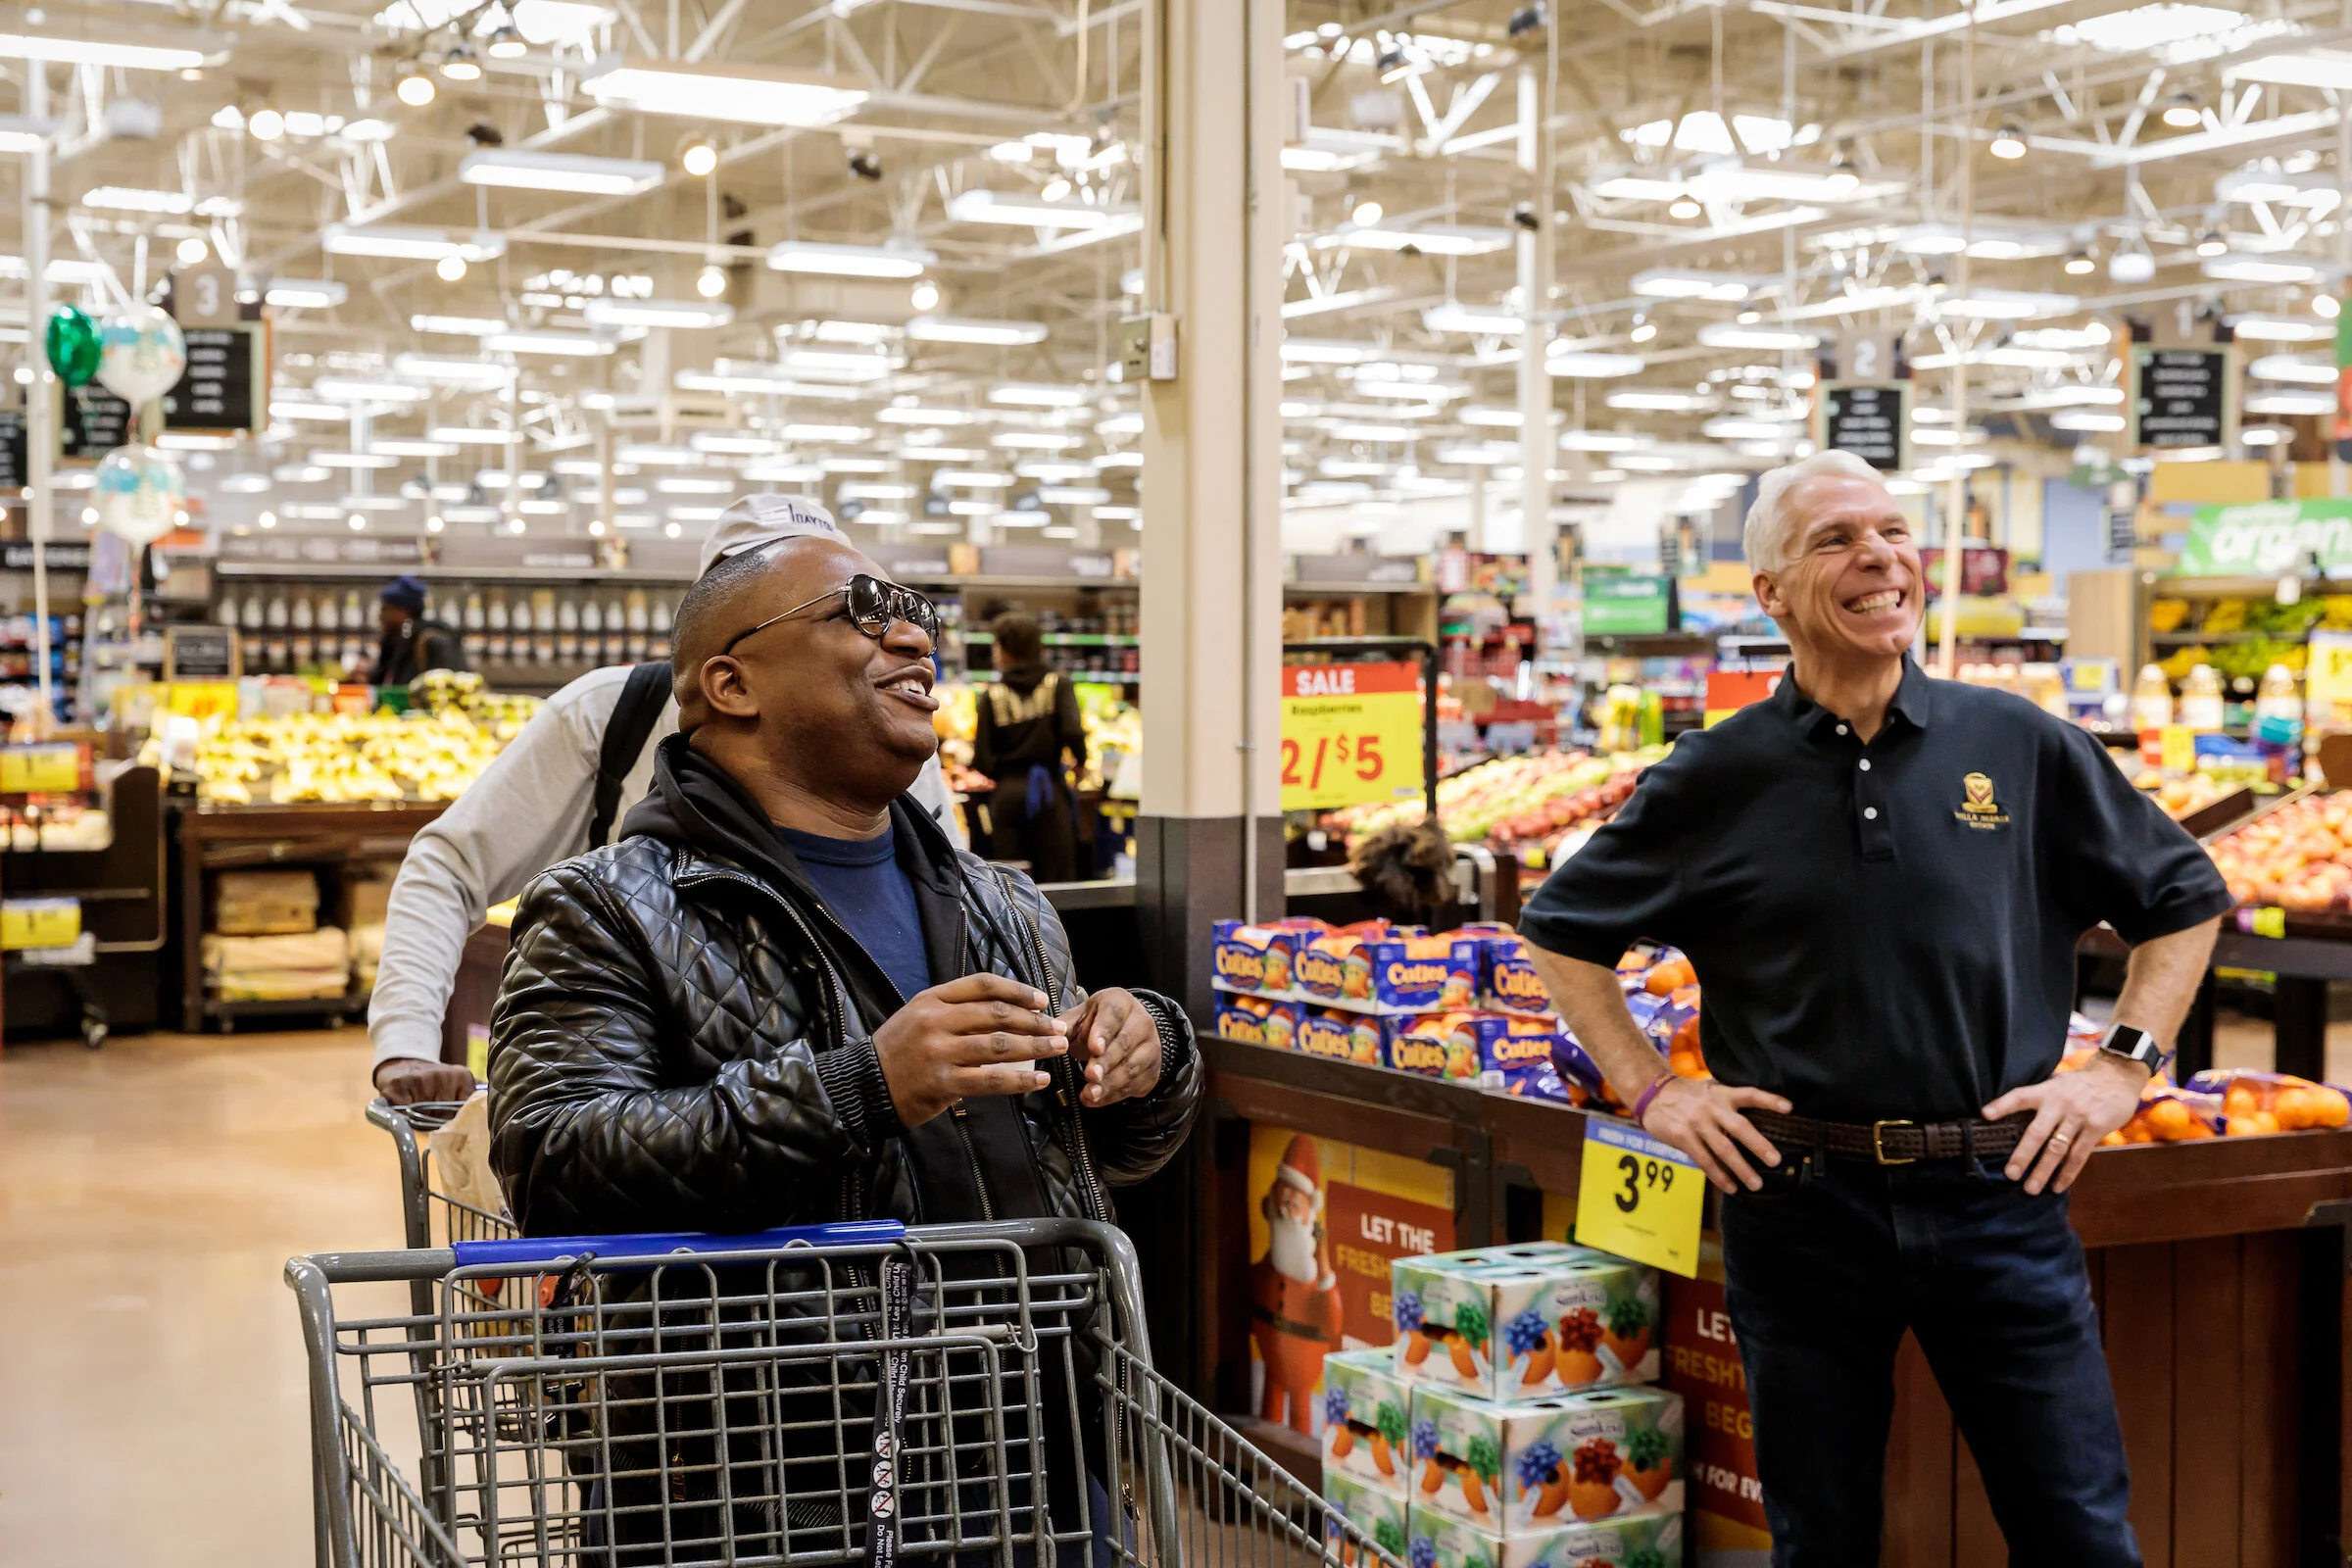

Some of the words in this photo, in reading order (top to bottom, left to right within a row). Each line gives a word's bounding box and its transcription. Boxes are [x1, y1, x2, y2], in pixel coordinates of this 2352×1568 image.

[196, 273, 219, 317] 3
[1854, 339, 1878, 377] 2
[1296, 668, 1355, 696] SALE
[1216, 945, 1264, 979] Cuties
[1295, 951, 1344, 987] Cuties
[1388, 962, 1448, 986] Cuties
[1298, 1021, 1351, 1058] Cuties
[1392, 1038, 1446, 1069] Cuties
[1493, 1038, 1552, 1061] Cuties
[1360, 1212, 1395, 1245] LET
[1396, 1221, 1435, 1254] THE
[1336, 1243, 1392, 1280] FRESH
[899, 1364, 907, 1387] Child
[895, 1388, 906, 1424] Securely
[1706, 1400, 1753, 1440] BEG
[1706, 1464, 1739, 1494] FOR
[876, 1538, 885, 1553] Not
[877, 1524, 886, 1537] Do
